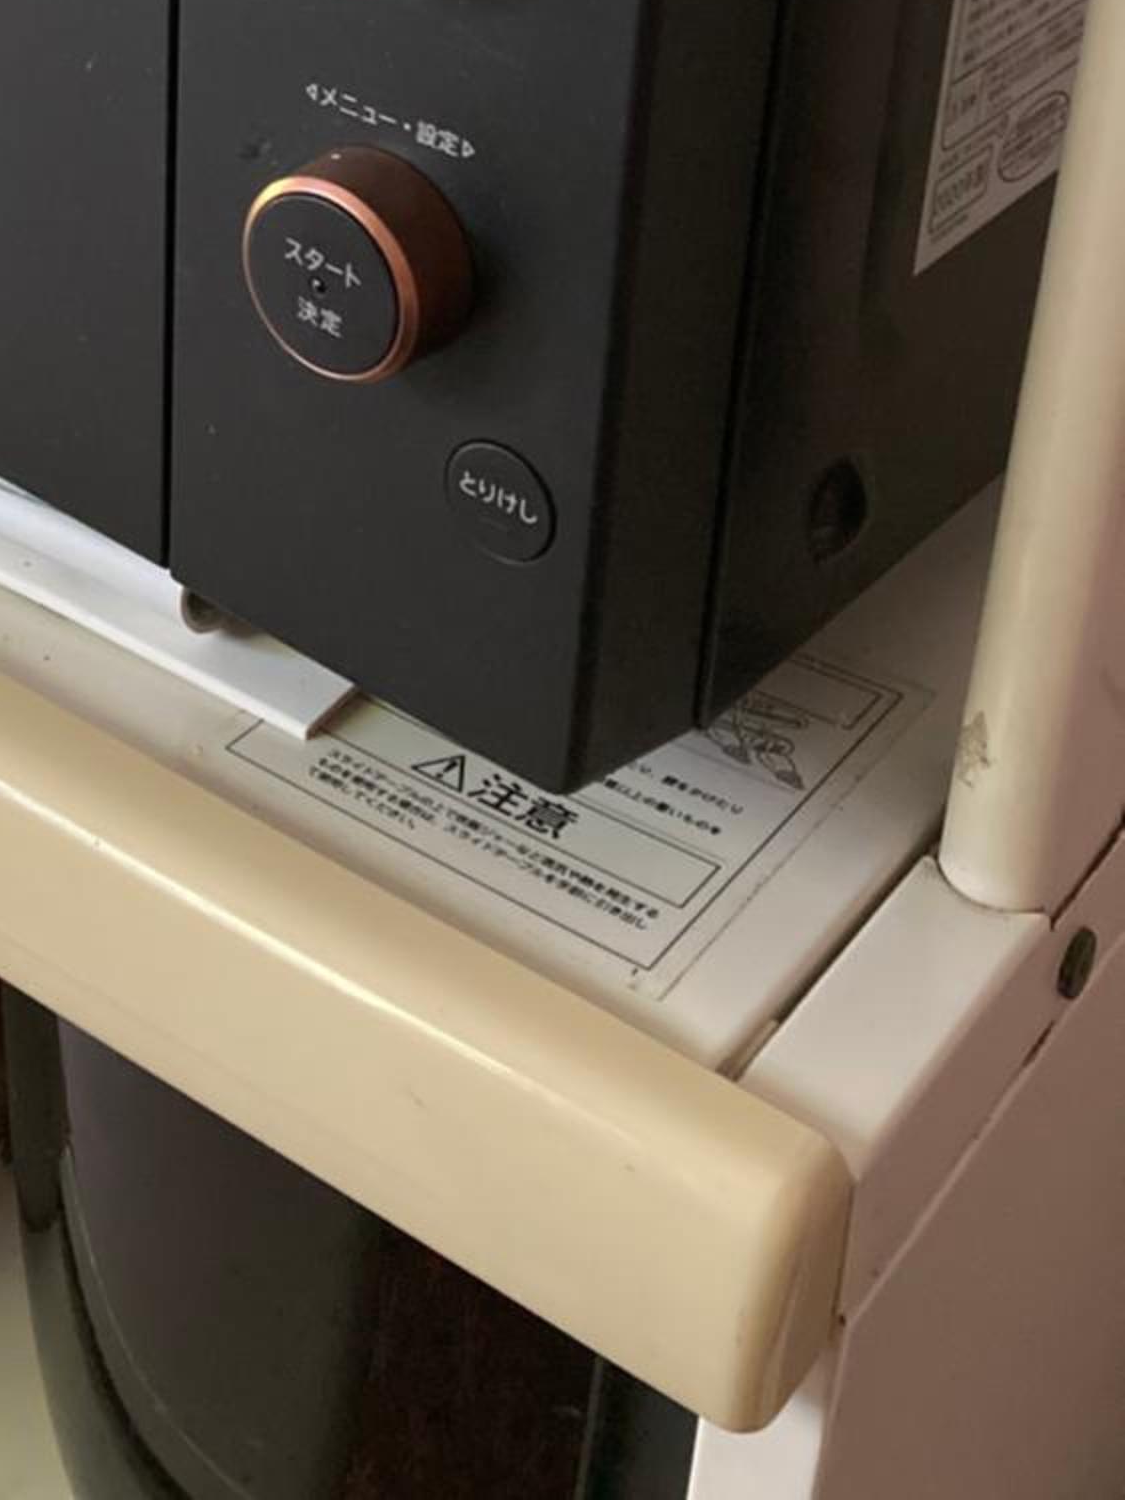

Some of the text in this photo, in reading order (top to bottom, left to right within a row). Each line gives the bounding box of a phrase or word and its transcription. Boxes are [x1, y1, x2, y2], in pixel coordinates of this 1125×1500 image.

[284, 237, 362, 289] スタート
[297, 297, 343, 338] 決定
[460, 471, 539, 525] とりけし
[467, 772, 579, 840] 注意
